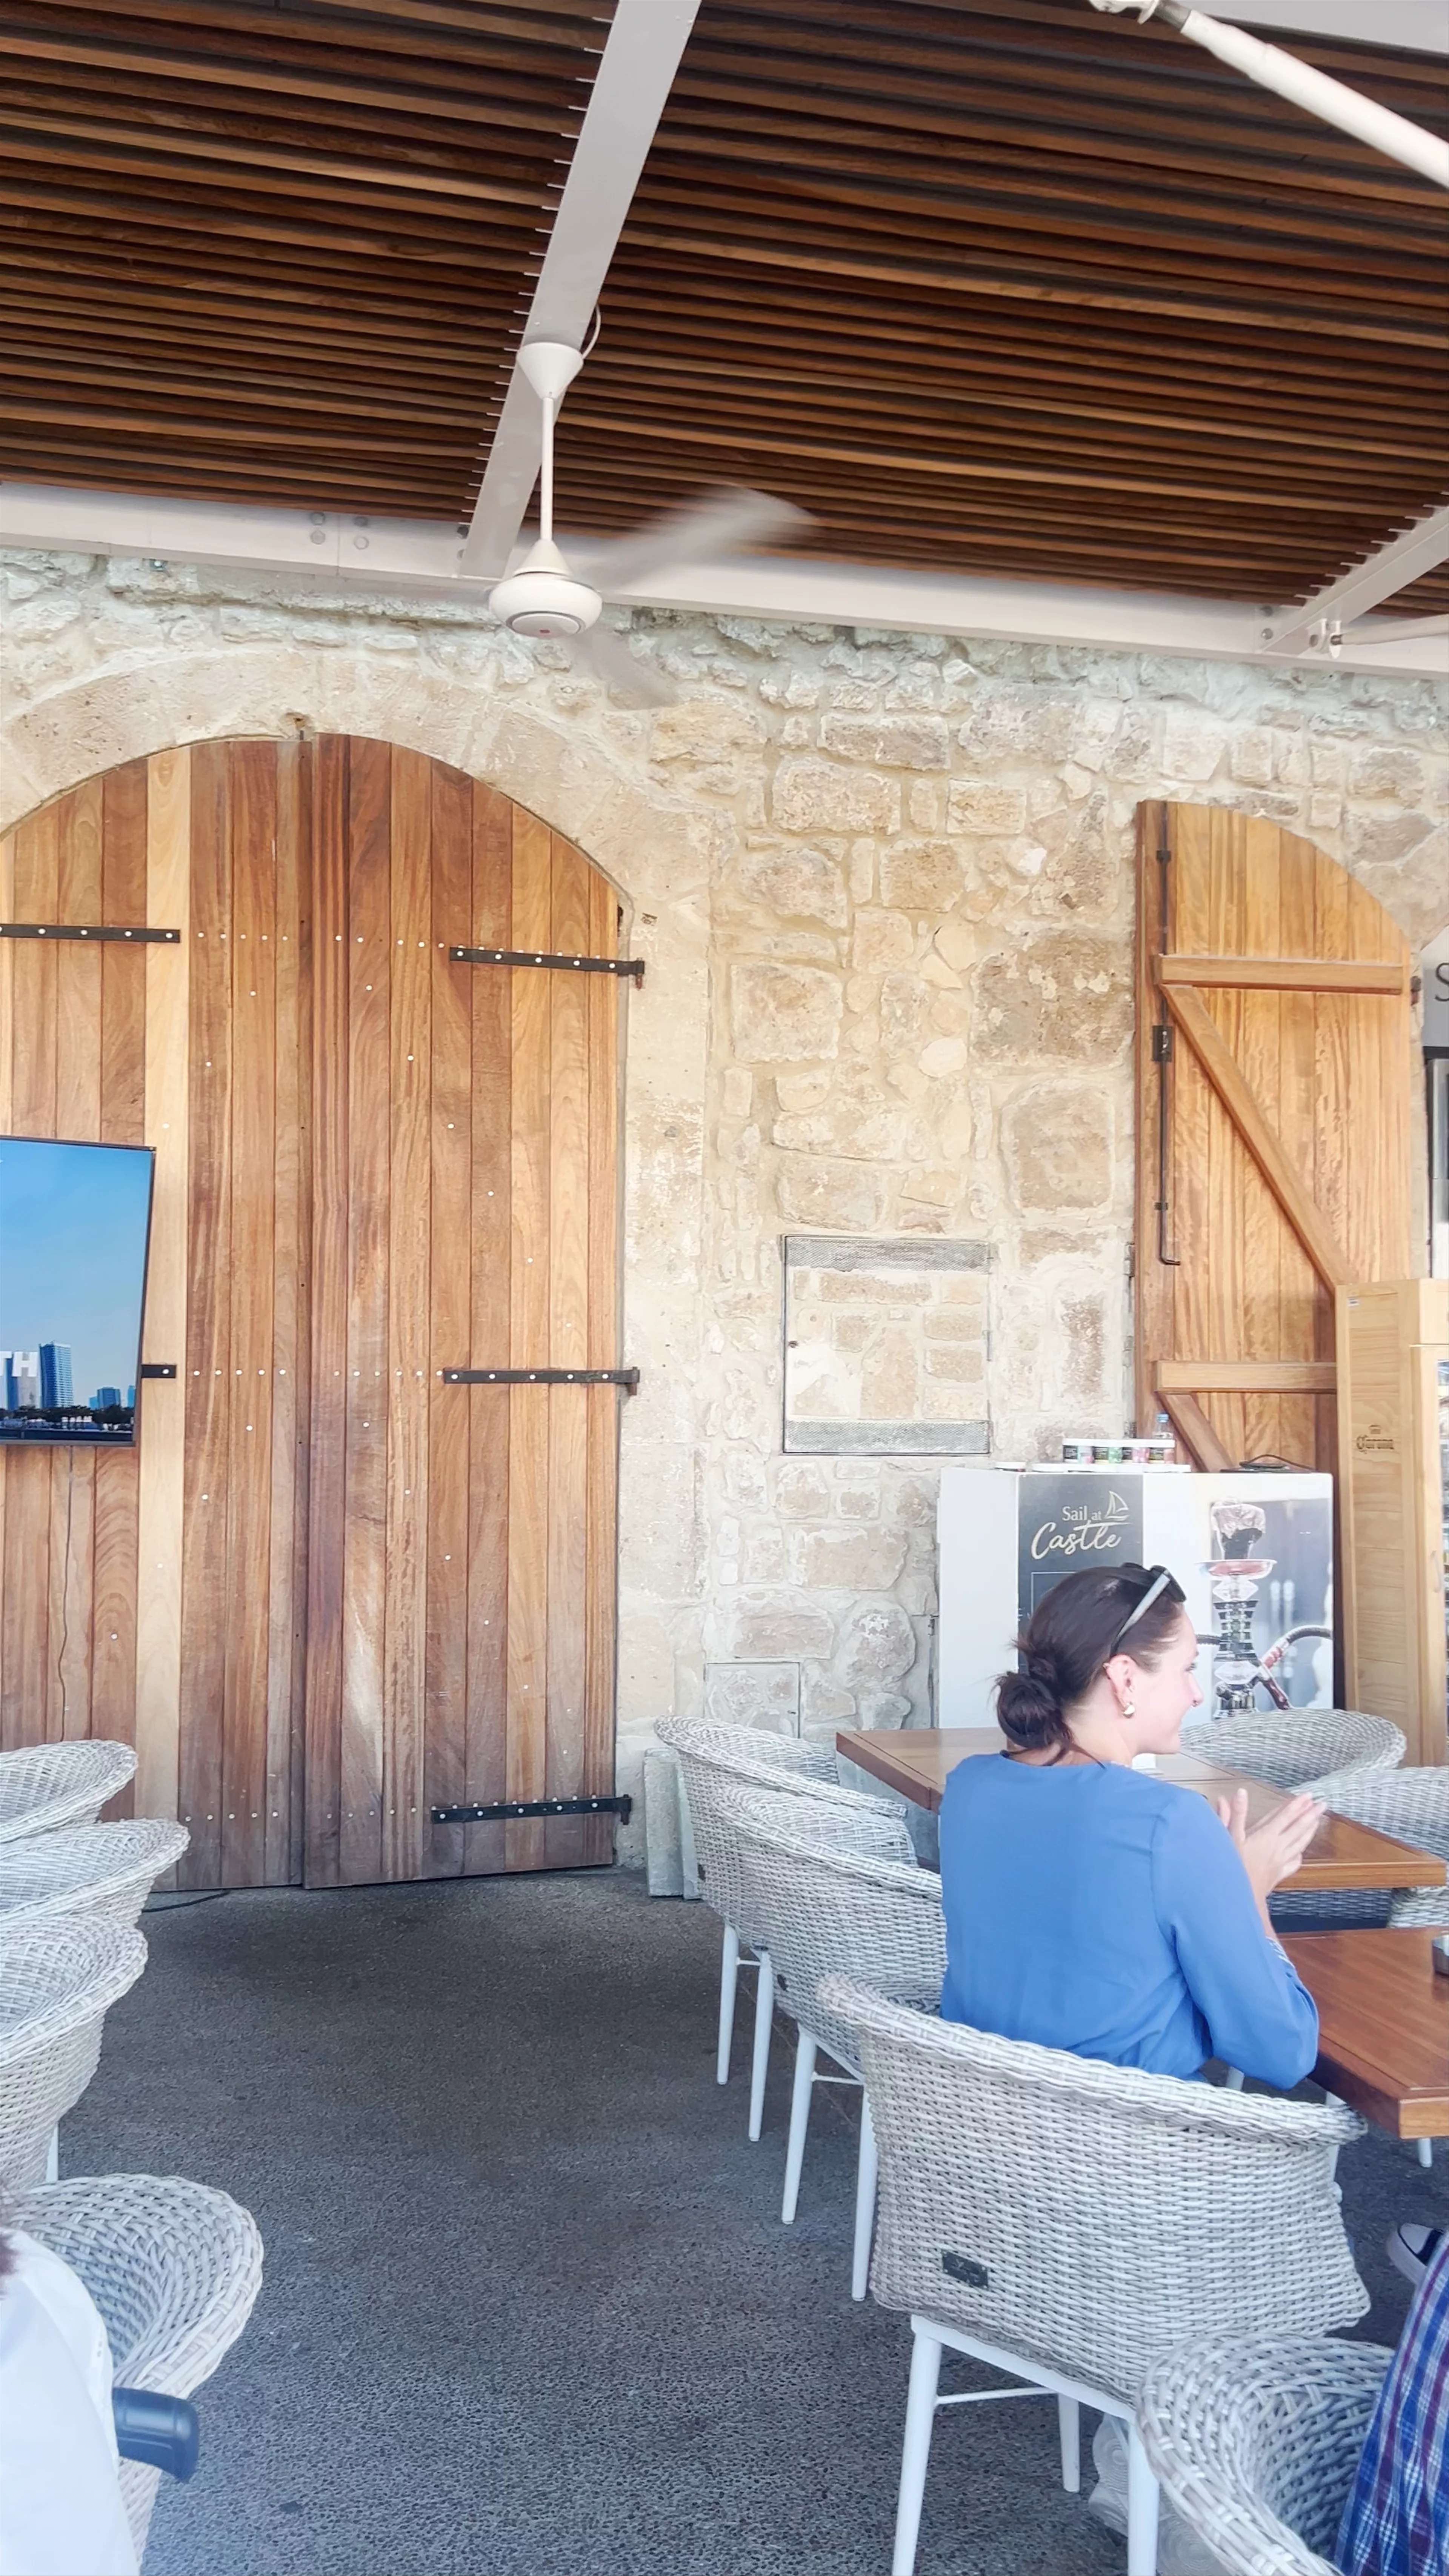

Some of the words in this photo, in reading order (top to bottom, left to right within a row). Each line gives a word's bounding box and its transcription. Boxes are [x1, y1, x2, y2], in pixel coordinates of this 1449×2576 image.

[1062, 1505, 1088, 1521] Sail
[1091, 1510, 1102, 1521] at
[1031, 1519, 1131, 1560] Castle
